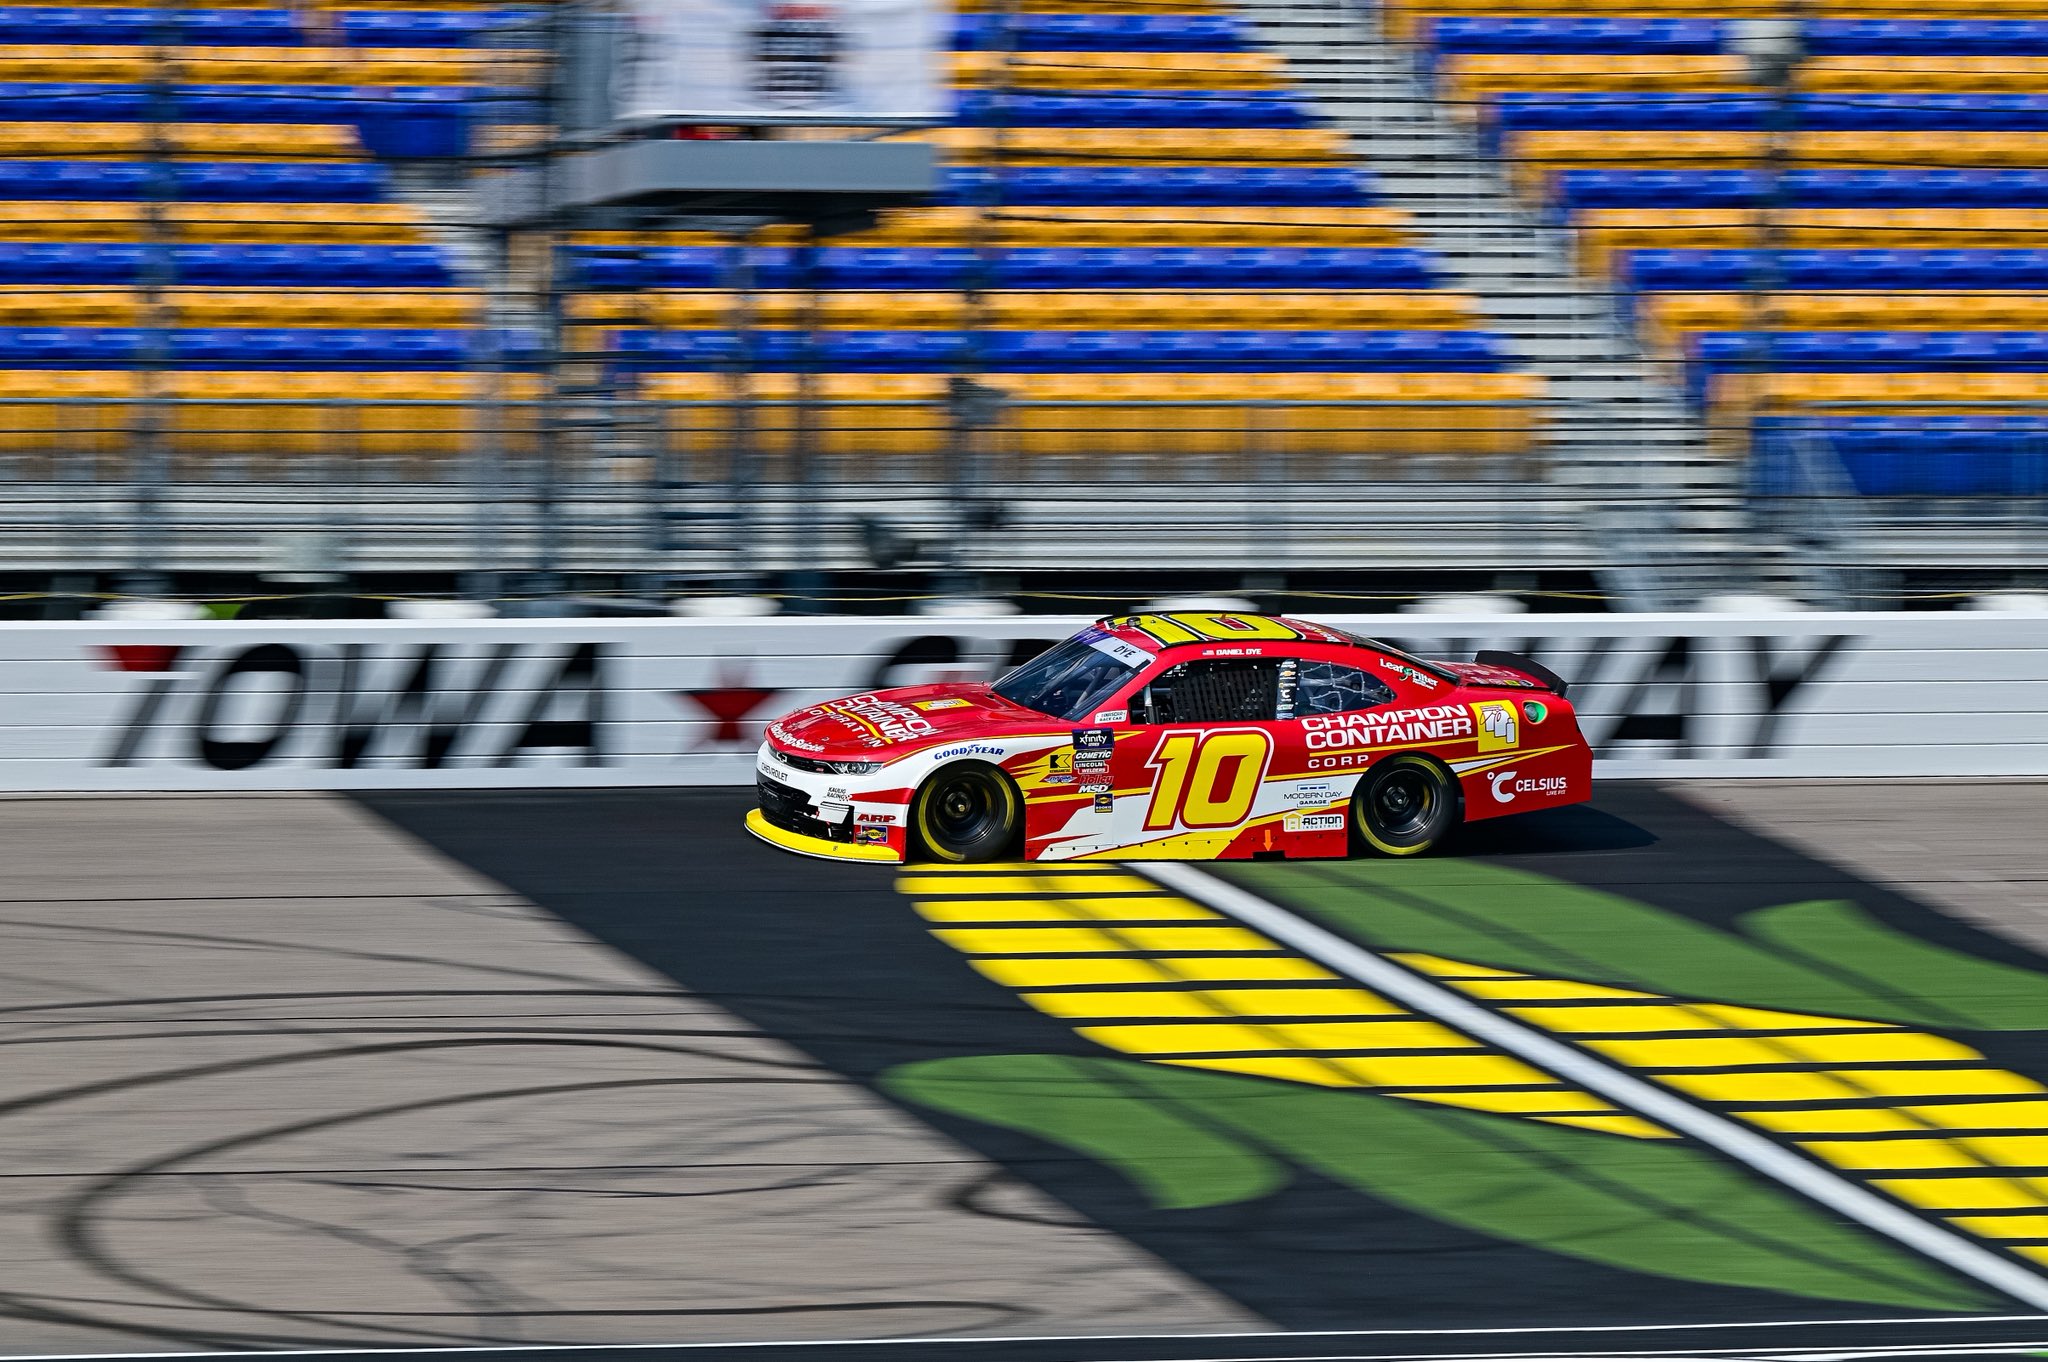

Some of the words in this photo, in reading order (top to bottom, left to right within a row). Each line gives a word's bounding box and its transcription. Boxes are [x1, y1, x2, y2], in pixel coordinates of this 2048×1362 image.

[1113, 645, 1137, 658] DYE
[1216, 648, 1244, 656] DANIEL
[1300, 703, 1469, 731] CHAMPION
[1079, 734, 1107, 745] xfinity
[1305, 717, 1473, 750] CONTAINER
[934, 744, 1005, 760] GOODYEAR
[1075, 749, 1112, 759] COMETIC
[1307, 754, 1369, 769] CORP
[761, 762, 788, 782] CHEVROLET
[1141, 726, 1275, 832] 10
[1515, 776, 1567, 793] CELSIUS
[1078, 784, 1109, 794] MSD
[1283, 792, 1323, 800] MODERN
[1324, 791, 1343, 799] DAY
[856, 813, 897, 823] ARP
[1301, 815, 1342, 826] ACTION
